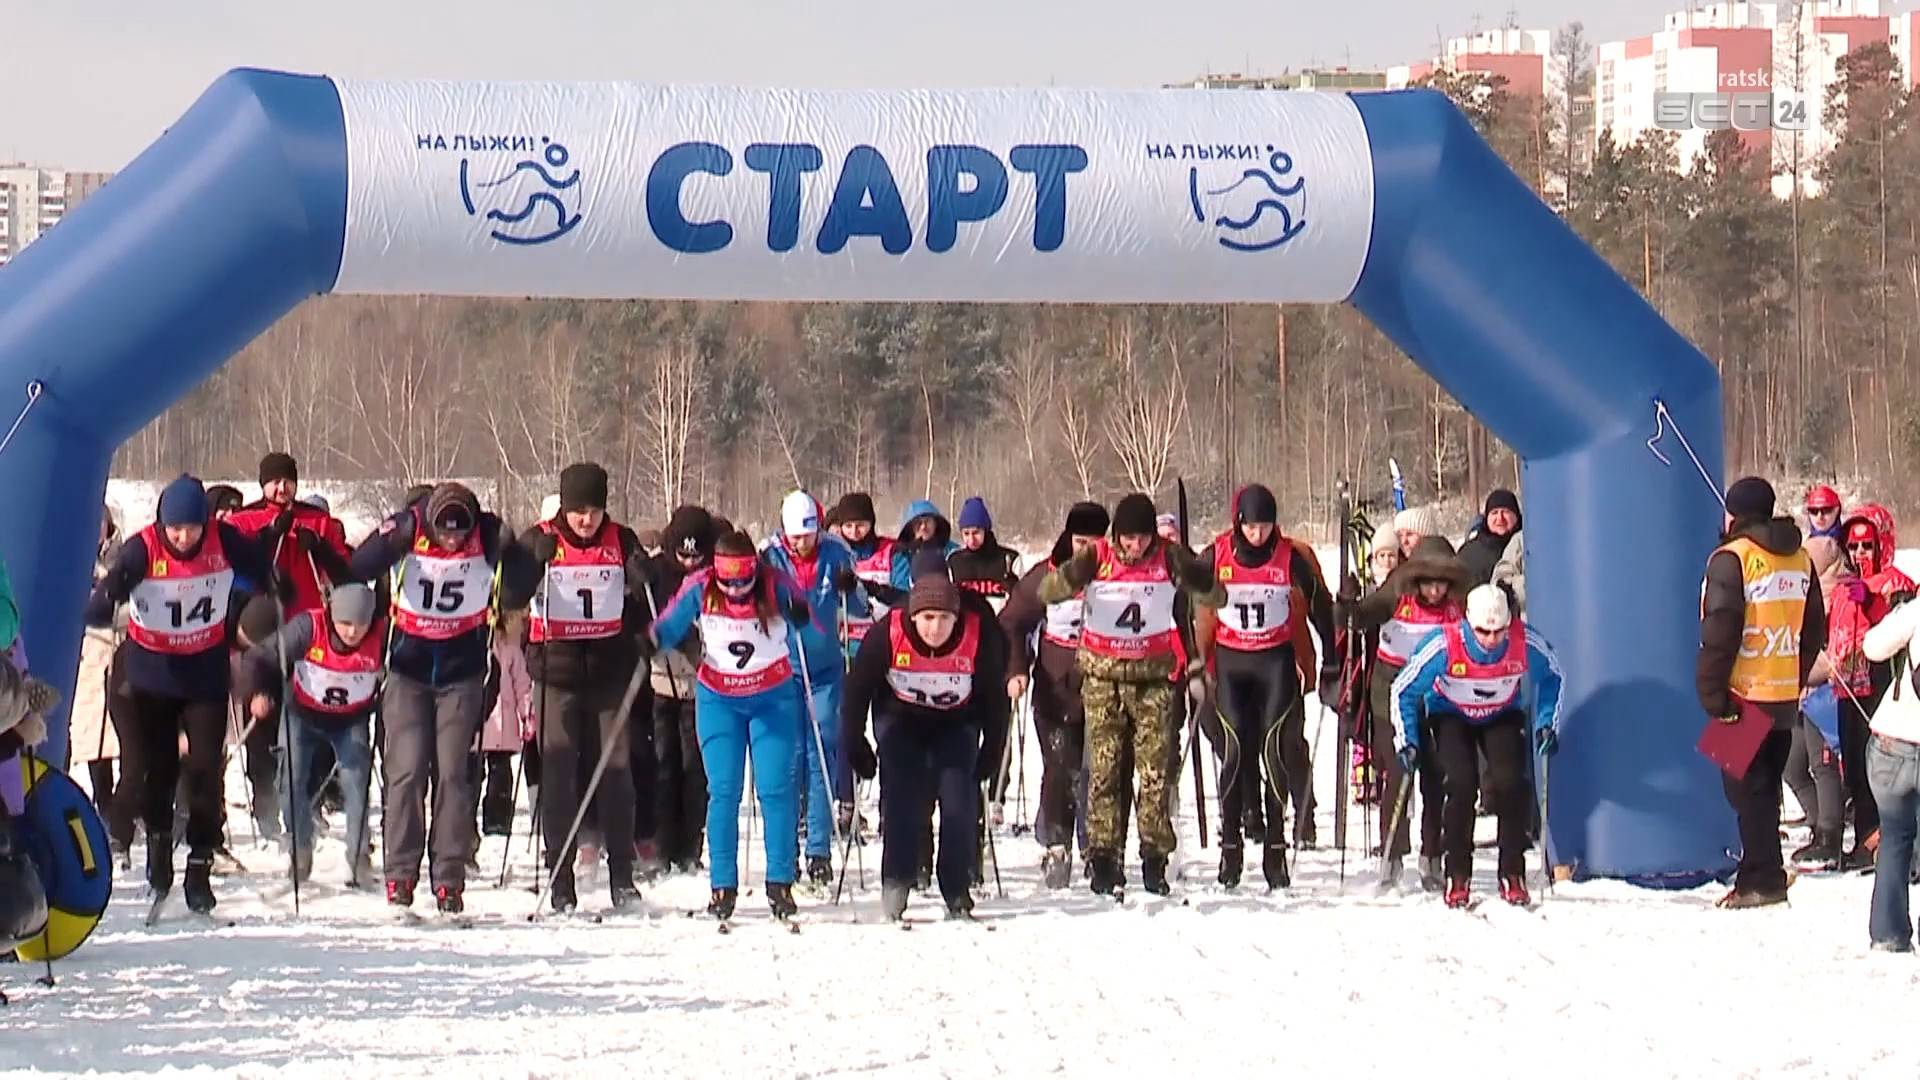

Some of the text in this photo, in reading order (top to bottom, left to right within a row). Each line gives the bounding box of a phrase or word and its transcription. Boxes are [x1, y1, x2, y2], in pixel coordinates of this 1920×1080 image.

[417, 133, 535, 151] НА ЛЫЖИ!
[1146, 143, 1260, 160] НА ЛЫЖИ!
[645, 141, 1088, 255] СТАРТ
[418, 577, 465, 613] 15
[576, 588, 594, 619] 1
[165, 596, 216, 628] 14
[1115, 602, 1147, 634] 4
[1233, 602, 1265, 630] 11
[728, 640, 756, 670] 9
